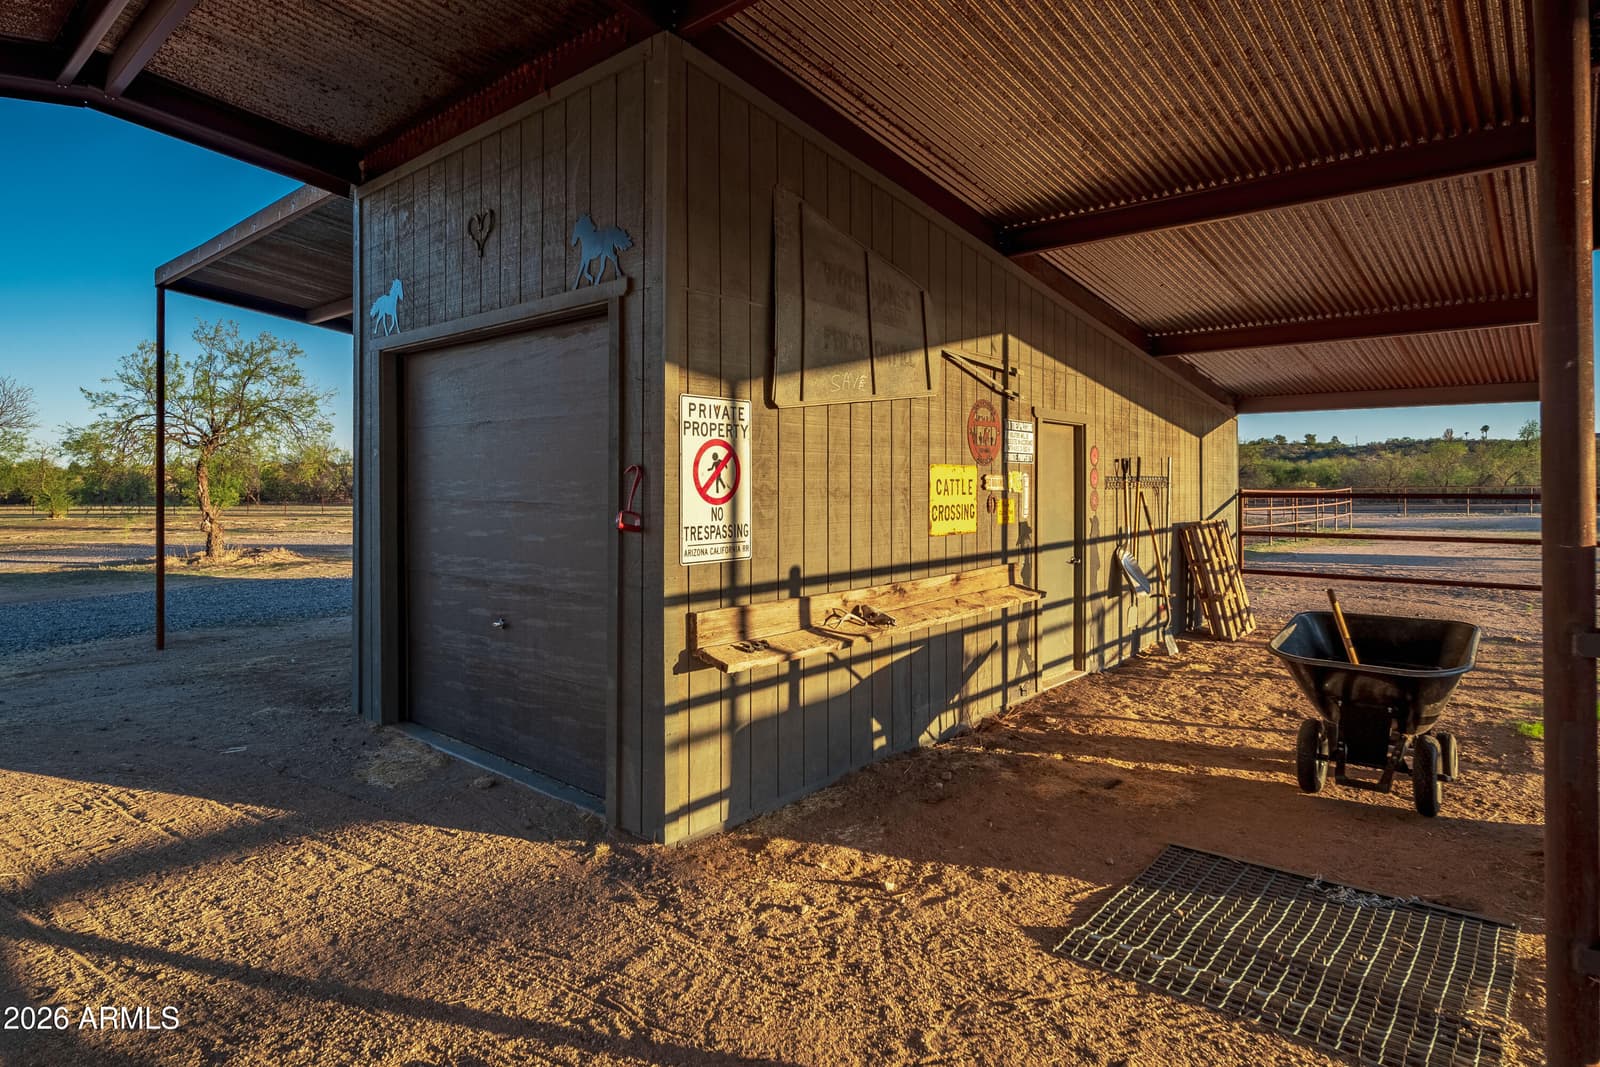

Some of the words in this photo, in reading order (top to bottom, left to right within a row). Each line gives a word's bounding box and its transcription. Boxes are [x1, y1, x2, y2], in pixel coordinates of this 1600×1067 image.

[688, 402, 745, 422] PRIVATE
[683, 420, 749, 439] PROPERTY
[935, 478, 974, 497] CATTLE
[710, 506, 724, 522] NO
[931, 503, 976, 522] CROSSING
[683, 522, 749, 542] TRESPASSING
[684, 547, 708, 557] ARIZONA
[709, 545, 741, 556] CALIFORNIA
